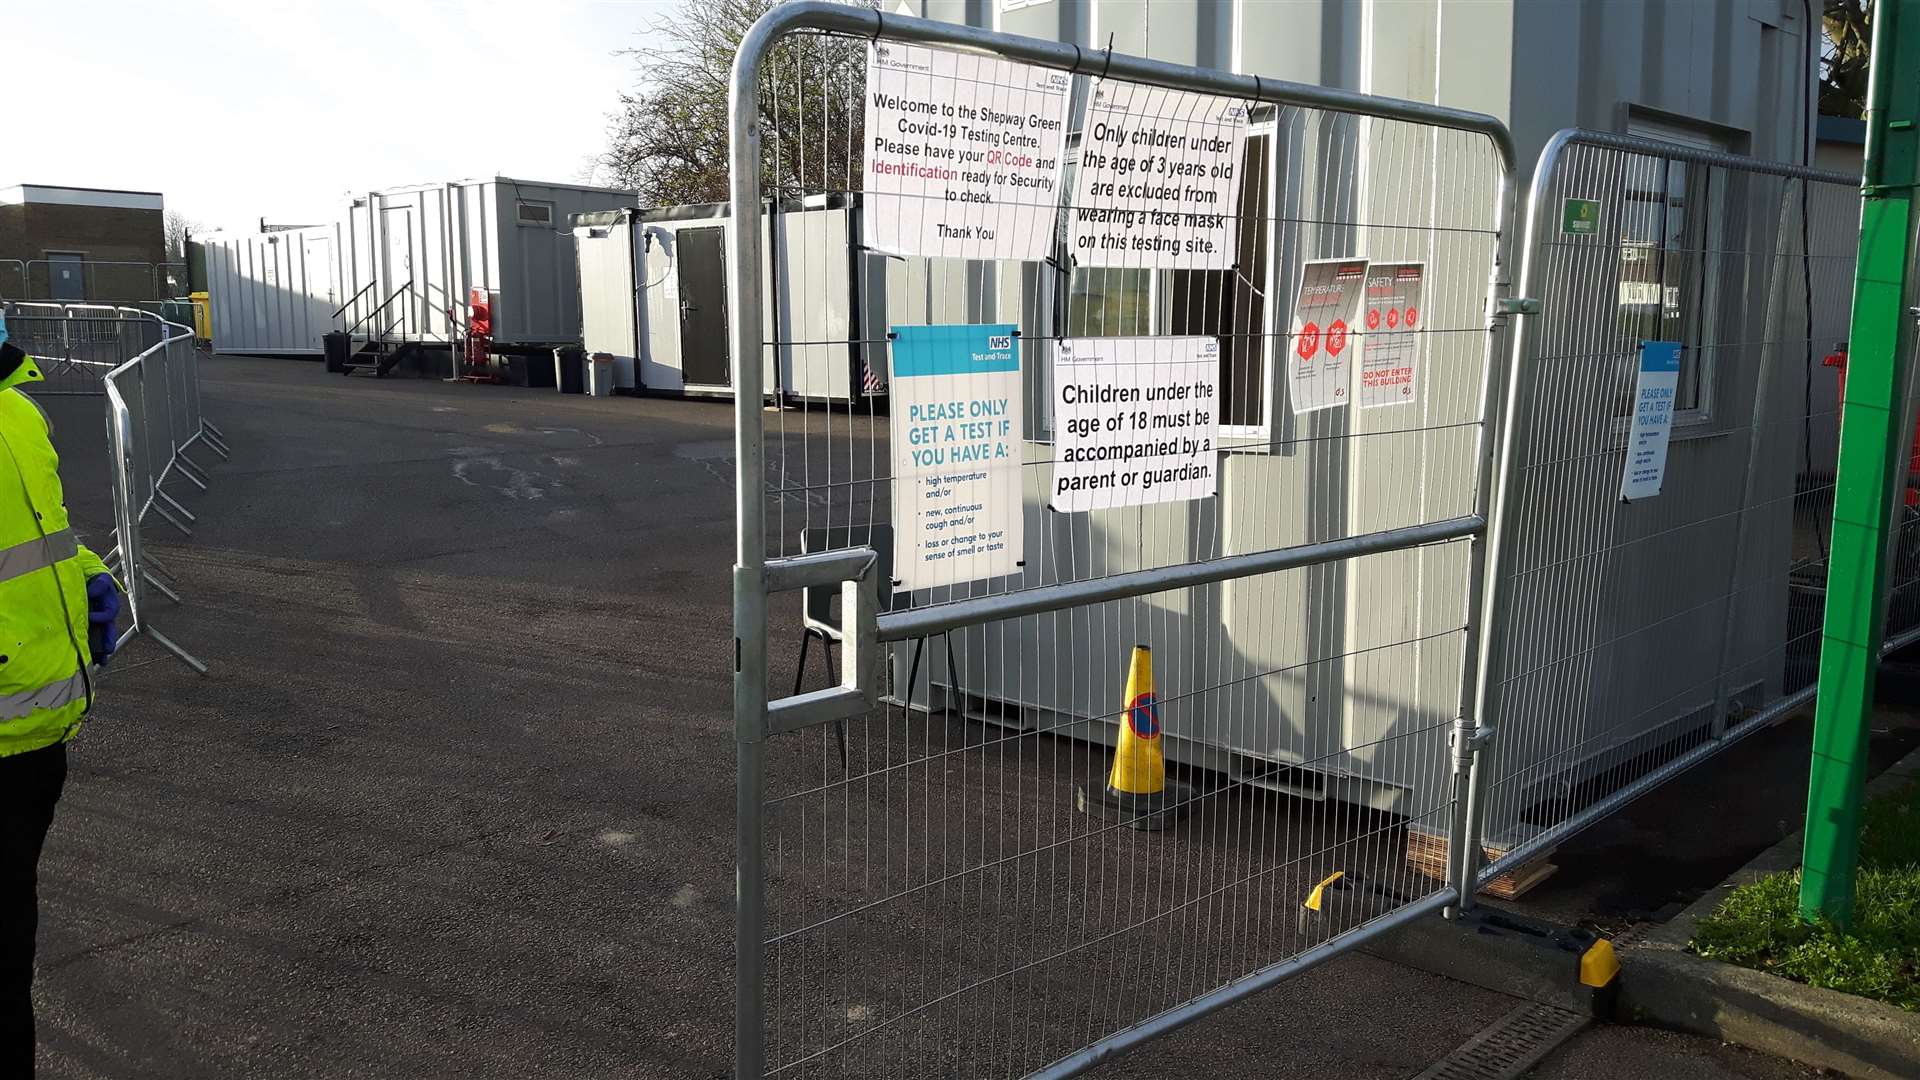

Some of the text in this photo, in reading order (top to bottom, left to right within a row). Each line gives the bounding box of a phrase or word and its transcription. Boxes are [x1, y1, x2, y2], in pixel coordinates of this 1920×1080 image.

[873, 92, 1061, 131] Welcome to the Shepway Green
[898, 118, 1040, 148] Covid-19 Testing Centre.
[1094, 122, 1231, 153] Only children under
[874, 137, 1055, 170] Please have your QR Code and
[1083, 150, 1233, 179] the age of 3 years old
[872, 159, 1054, 192] Identification ready for Security
[945, 188, 994, 204] to check.
[1090, 181, 1217, 203] are excluded from
[1078, 206, 1224, 230] wearing a face mask
[937, 224, 994, 240] Thank You
[1078, 232, 1217, 256] on this testing site.
[1368, 276, 1393, 288] SAFETY
[990, 337, 1010, 349] NHS
[997, 352, 1011, 360] Trace
[1364, 368, 1412, 380] DO NOT ENTER
[1364, 376, 1412, 388] THIS BUILDING
[1062, 380, 1213, 404] Children under the
[1642, 388, 1660, 399] PLEASE
[910, 399, 1008, 422] PLEASE ONLY
[910, 420, 1010, 445] GET A TEST IF
[1068, 408, 1210, 438] age of 18 must be
[912, 442, 1008, 467] YOU HAVE A:
[1064, 436, 1210, 462] accompanied by a
[926, 472, 987, 487] high temperature
[1058, 463, 1212, 496] parent or guardian.
[926, 488, 951, 498] and/or
[926, 503, 982, 518] new, continuous
[926, 515, 975, 530] cough and/or
[925, 540, 939, 548] loss
[950, 534, 976, 544] change
[979, 532, 986, 540] to
[988, 530, 1003, 540] your
[925, 552, 946, 562] sense
[948, 548, 955, 558] of
[957, 545, 975, 556] smell
[986, 542, 1004, 552] taste
